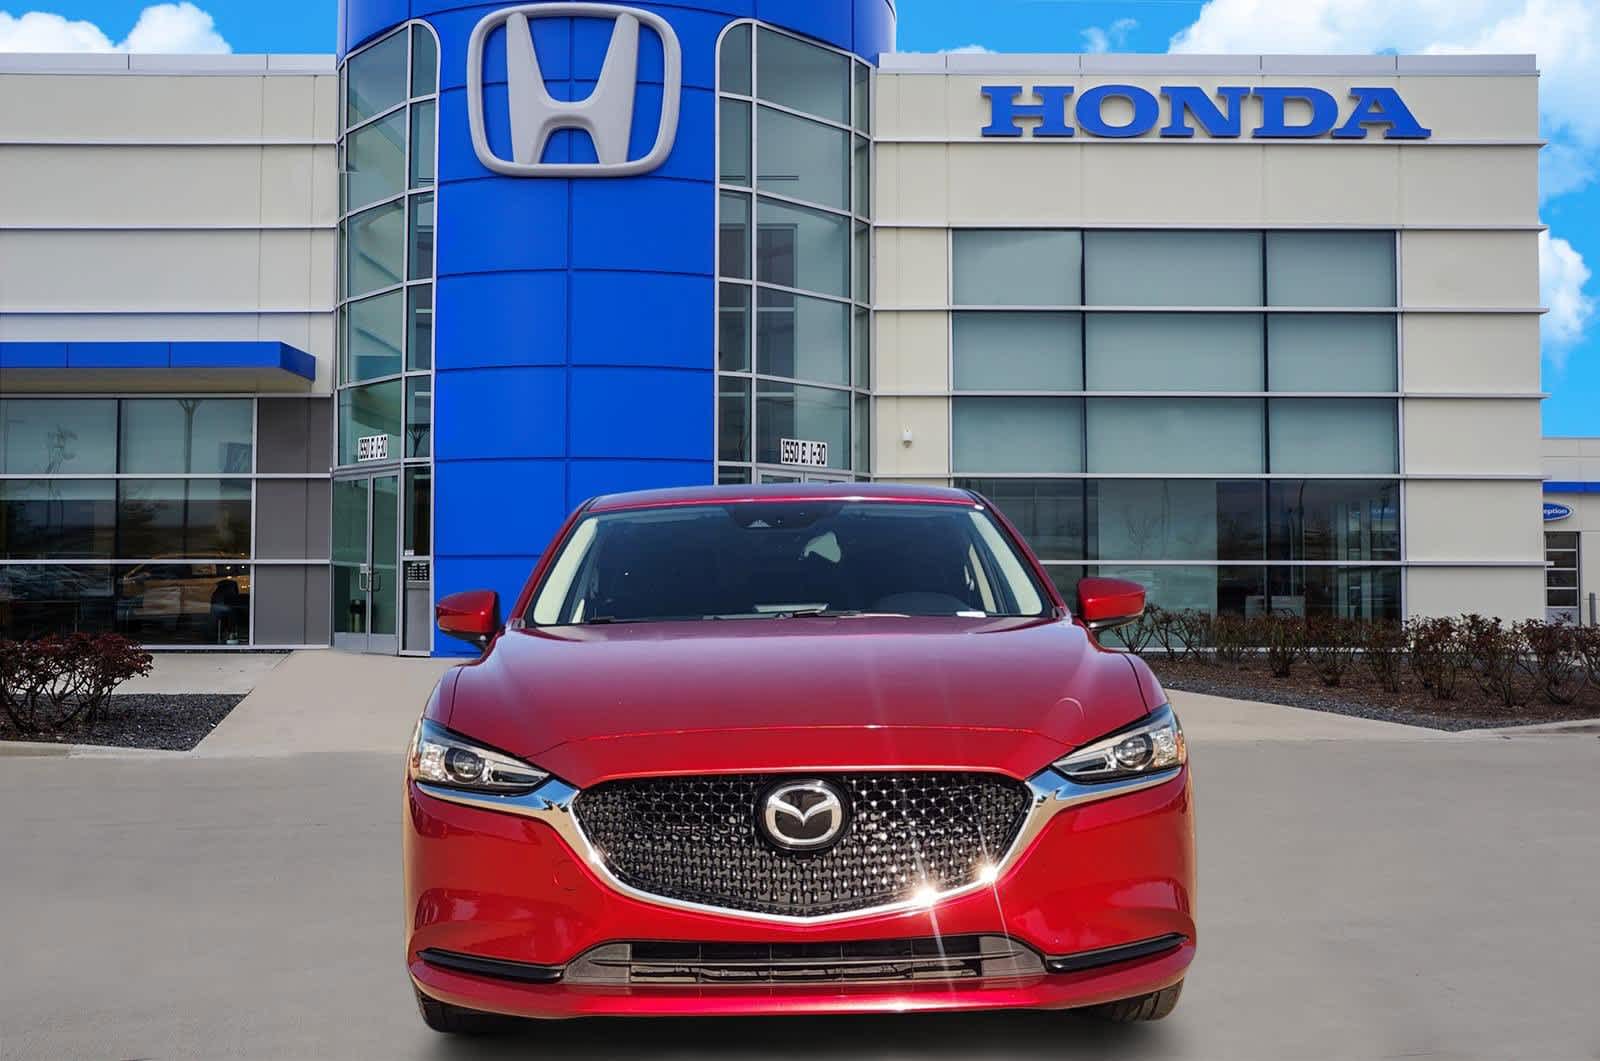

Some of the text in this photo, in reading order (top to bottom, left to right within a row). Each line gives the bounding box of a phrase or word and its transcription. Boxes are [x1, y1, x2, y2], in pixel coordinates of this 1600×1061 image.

[980, 84, 1432, 139] HONDA
[782, 440, 799, 463] 1550
[810, 443, 826, 465] I-30
